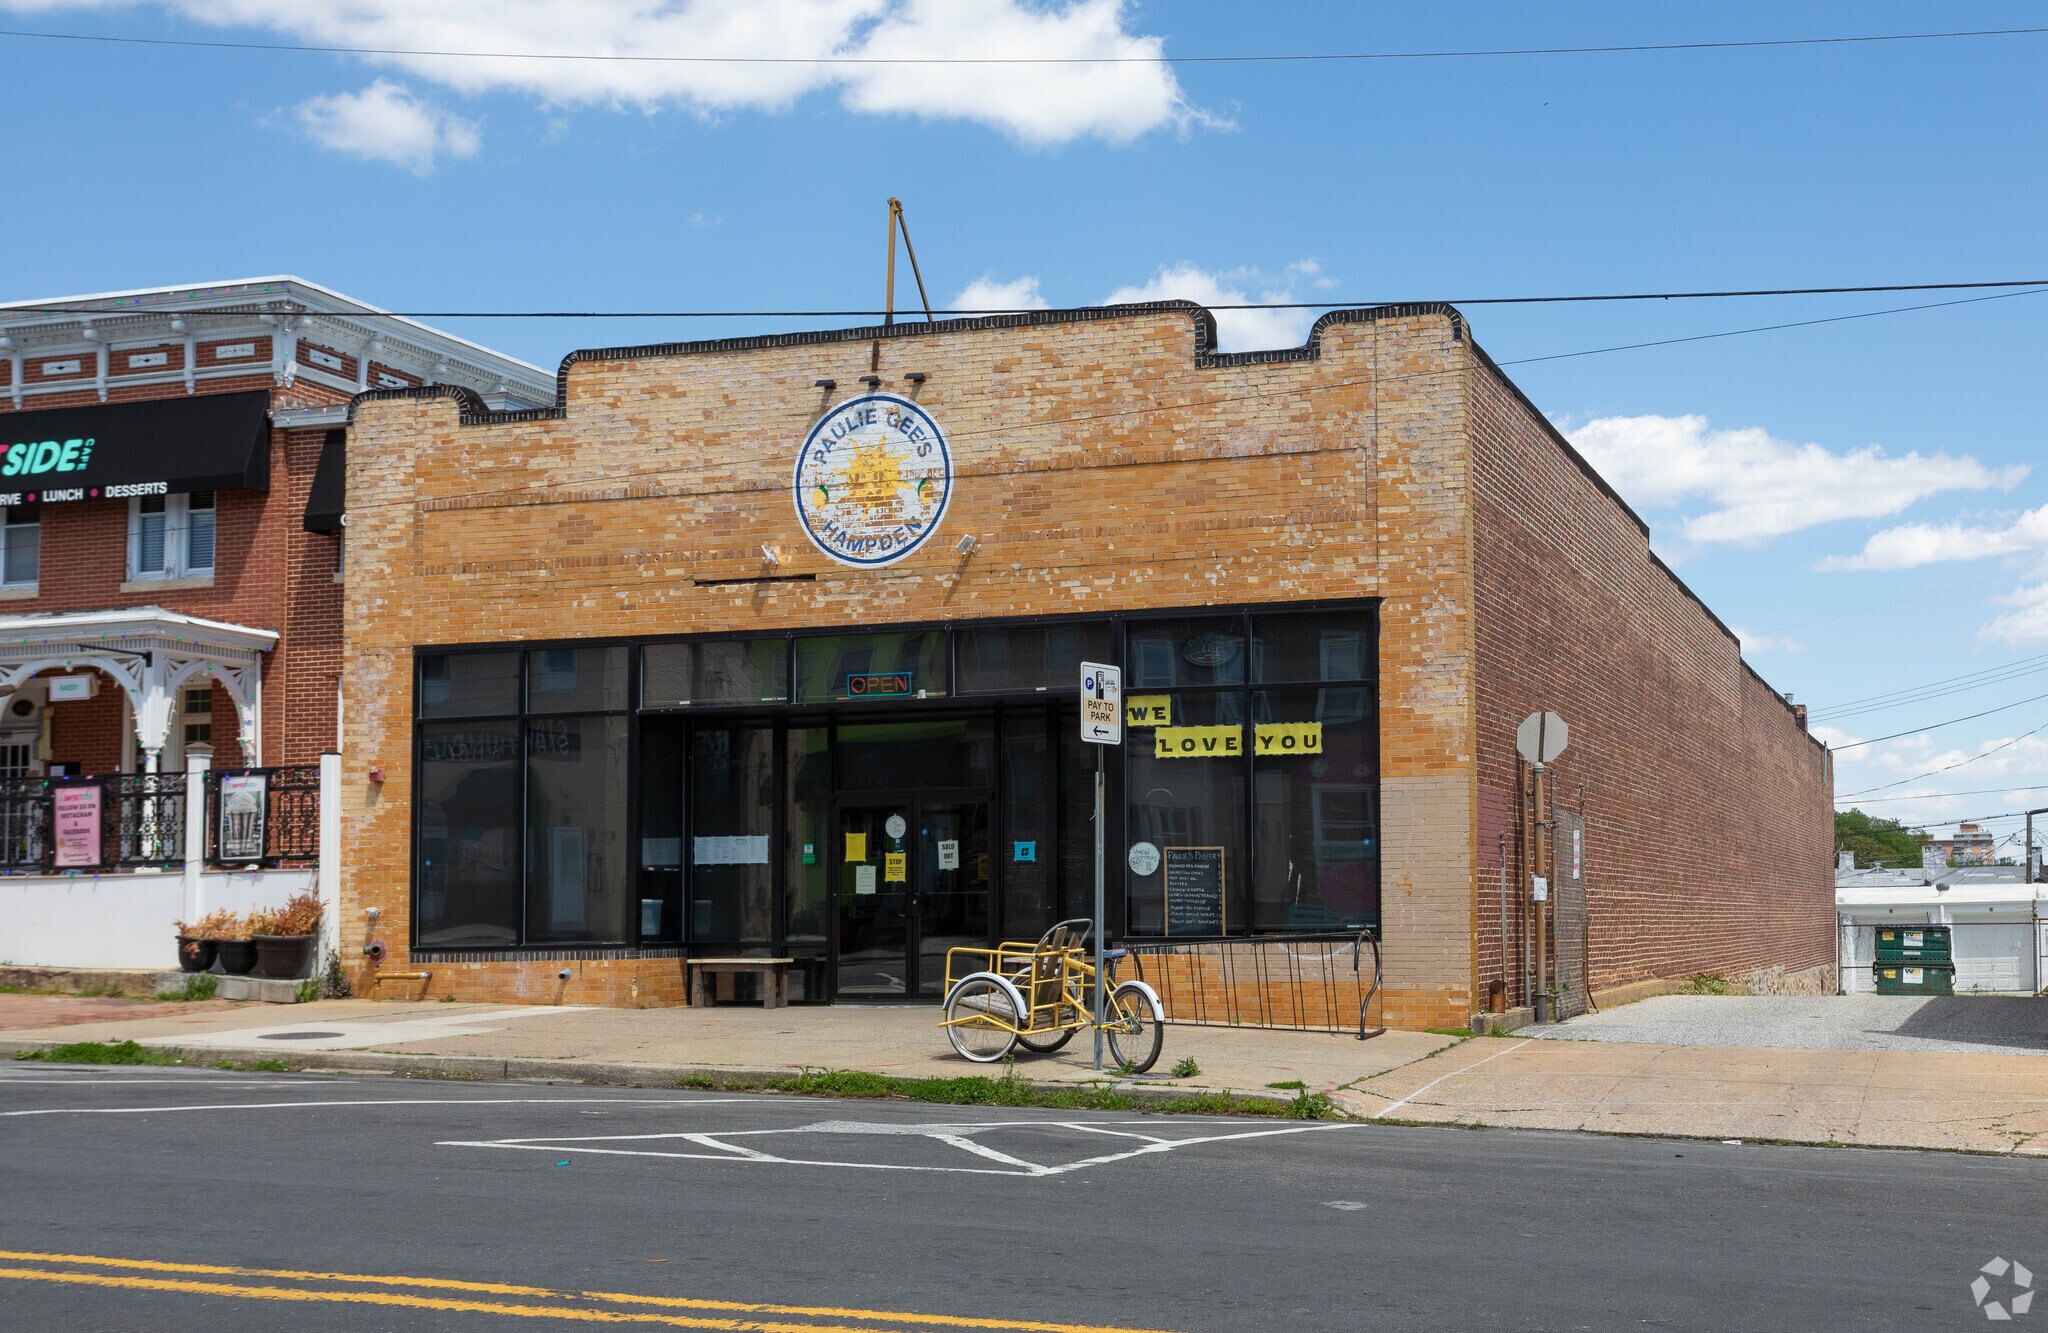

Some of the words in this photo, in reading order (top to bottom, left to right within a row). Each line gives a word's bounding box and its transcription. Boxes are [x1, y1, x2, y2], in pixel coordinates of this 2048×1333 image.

[813, 408, 877, 465] PAULIE
[76, 438, 95, 471] CAFE
[42, 488, 83, 502] LUNCH
[105, 481, 168, 498] DESSERTS
[822, 516, 922, 553] HAMPDEN
[850, 675, 908, 694] OPEN
[1088, 700, 1102, 711] PAY
[1104, 702, 1114, 712] TO
[1129, 706, 1166, 721] WE
[1091, 711, 1111, 722] PARK
[1159, 736, 1238, 753] LOVE
[1259, 734, 1317, 750] YOU
[61, 811, 92, 819] INSTAGRAM
[889, 858, 902, 866] STOP
[1195, 851, 1221, 861] PANTRY
